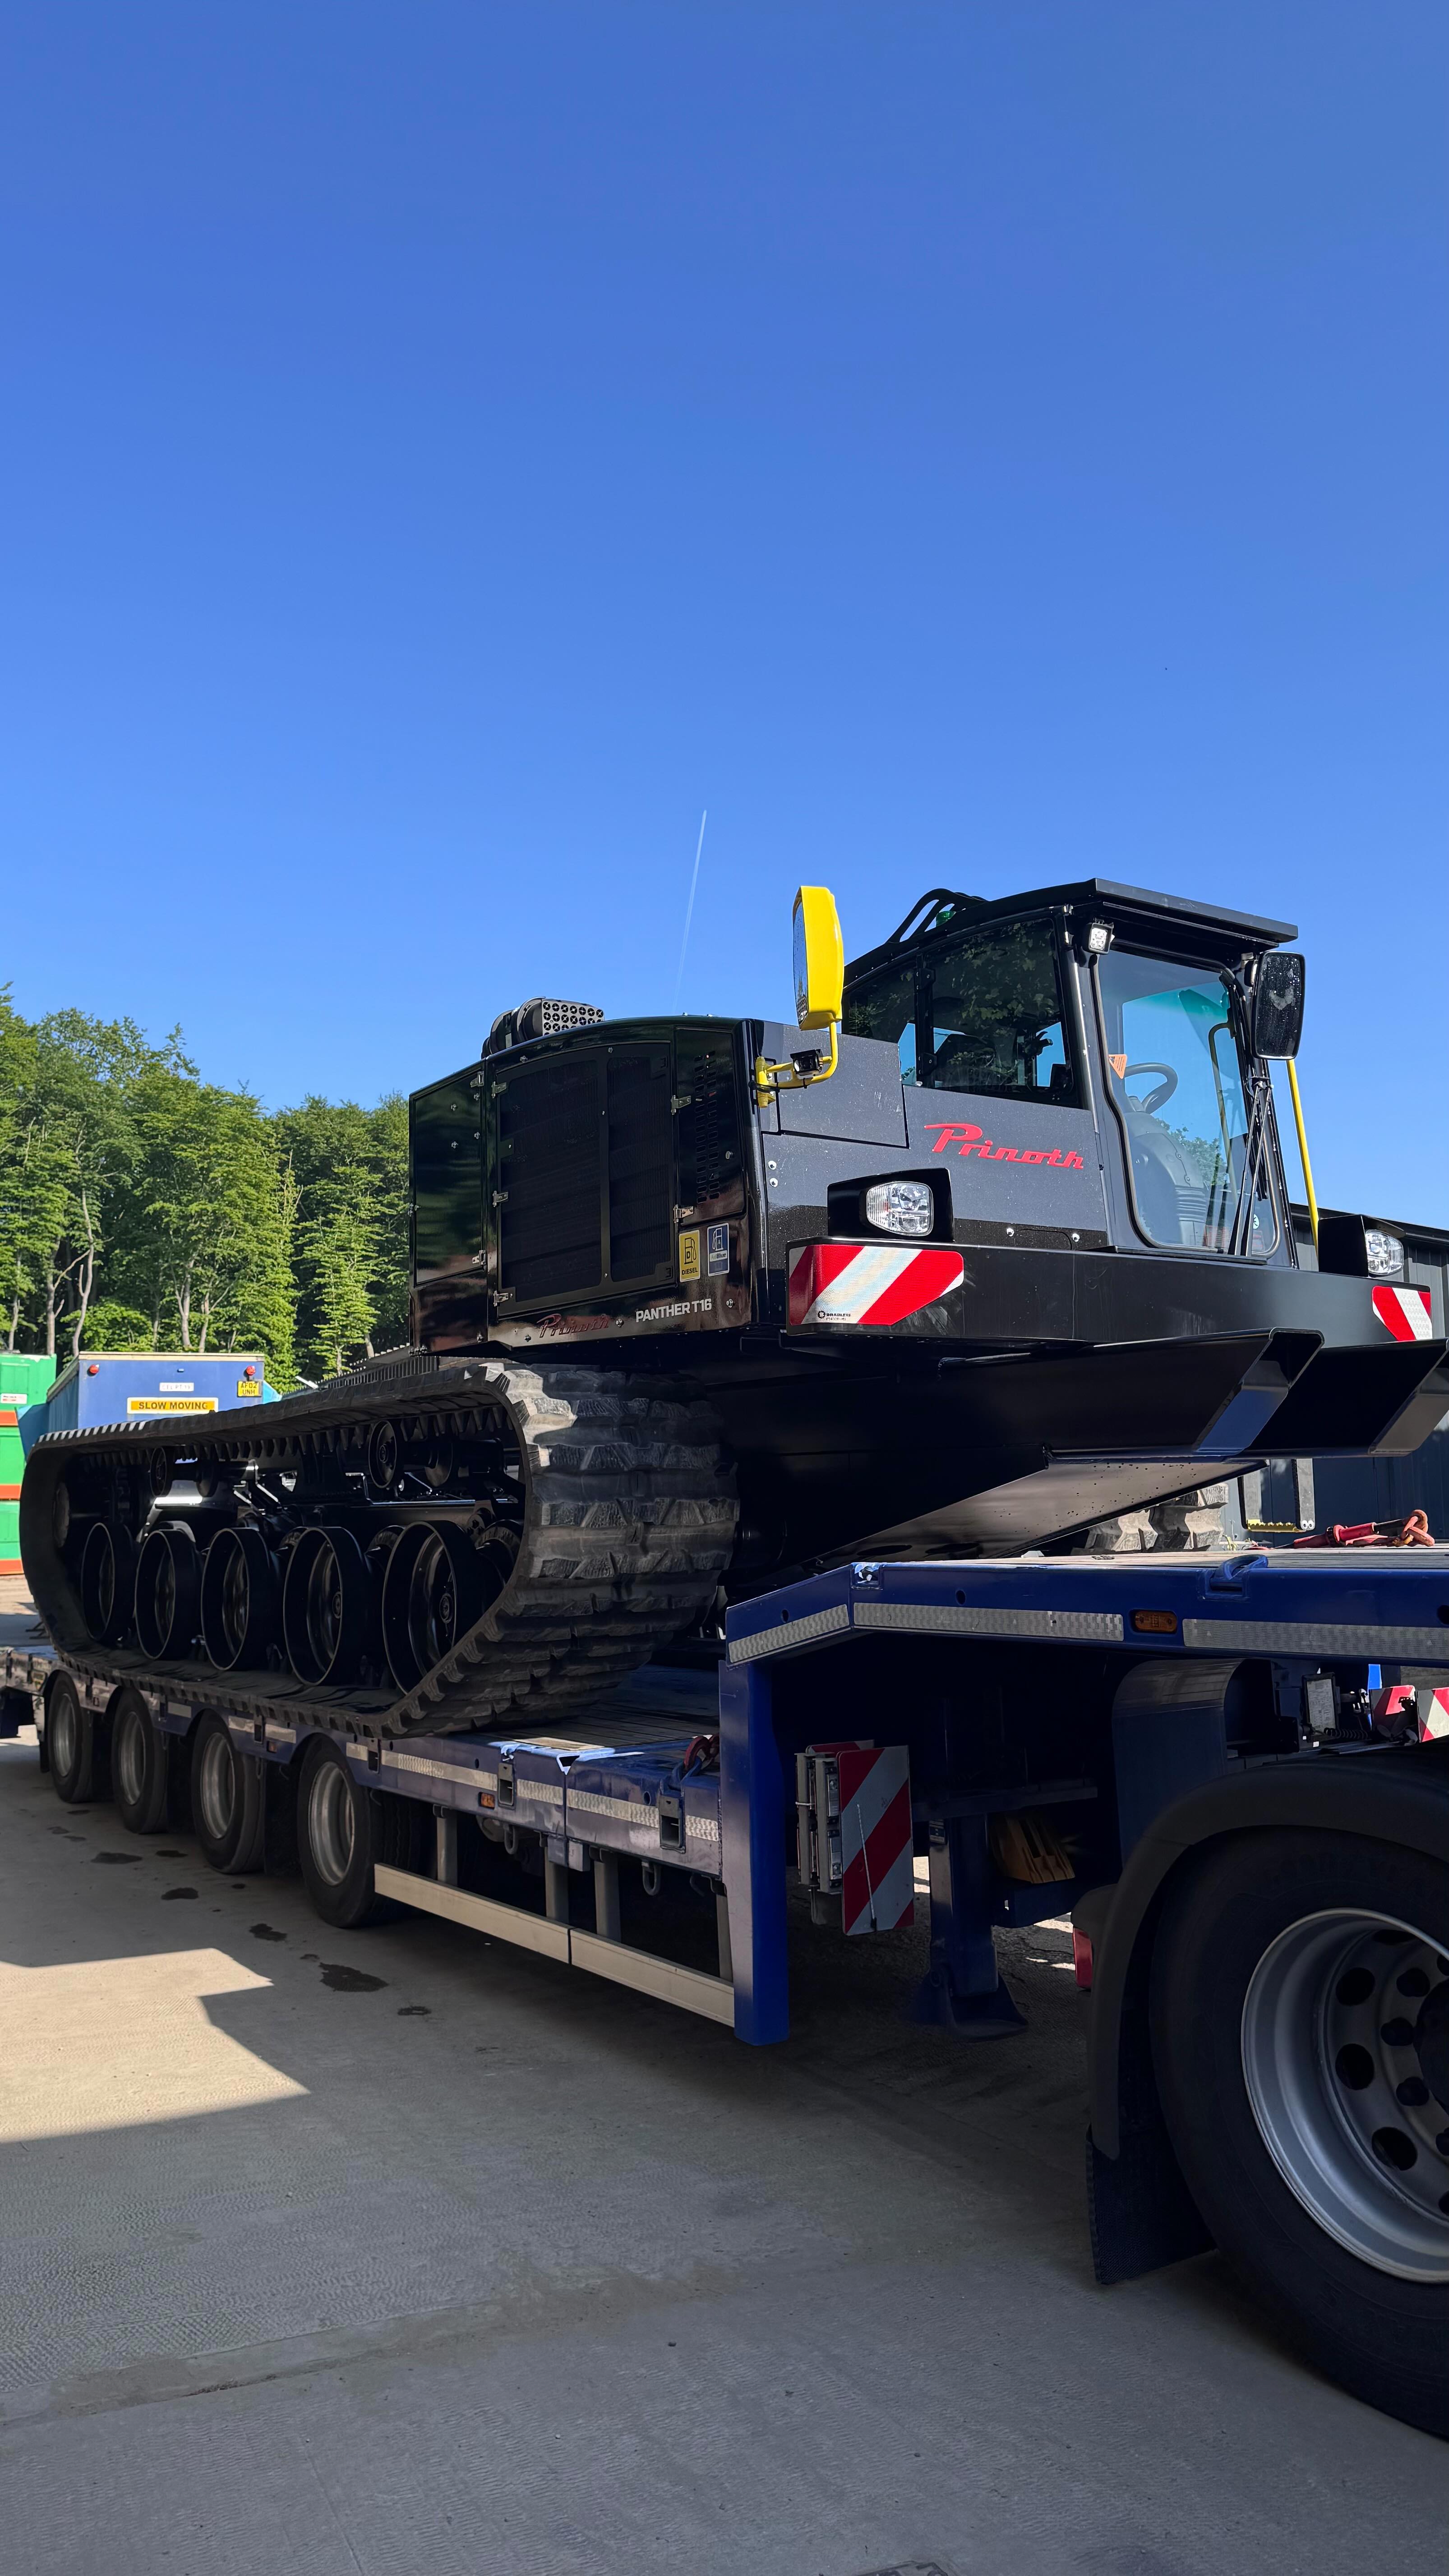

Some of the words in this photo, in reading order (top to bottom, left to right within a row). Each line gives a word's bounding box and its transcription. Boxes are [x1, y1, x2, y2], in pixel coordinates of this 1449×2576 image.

[924, 1123, 1083, 1169] Prinoth
[636, 1302, 690, 1322] PANTHER
[692, 1298, 712, 1312] T16
[537, 1313, 609, 1338] Prinoth
